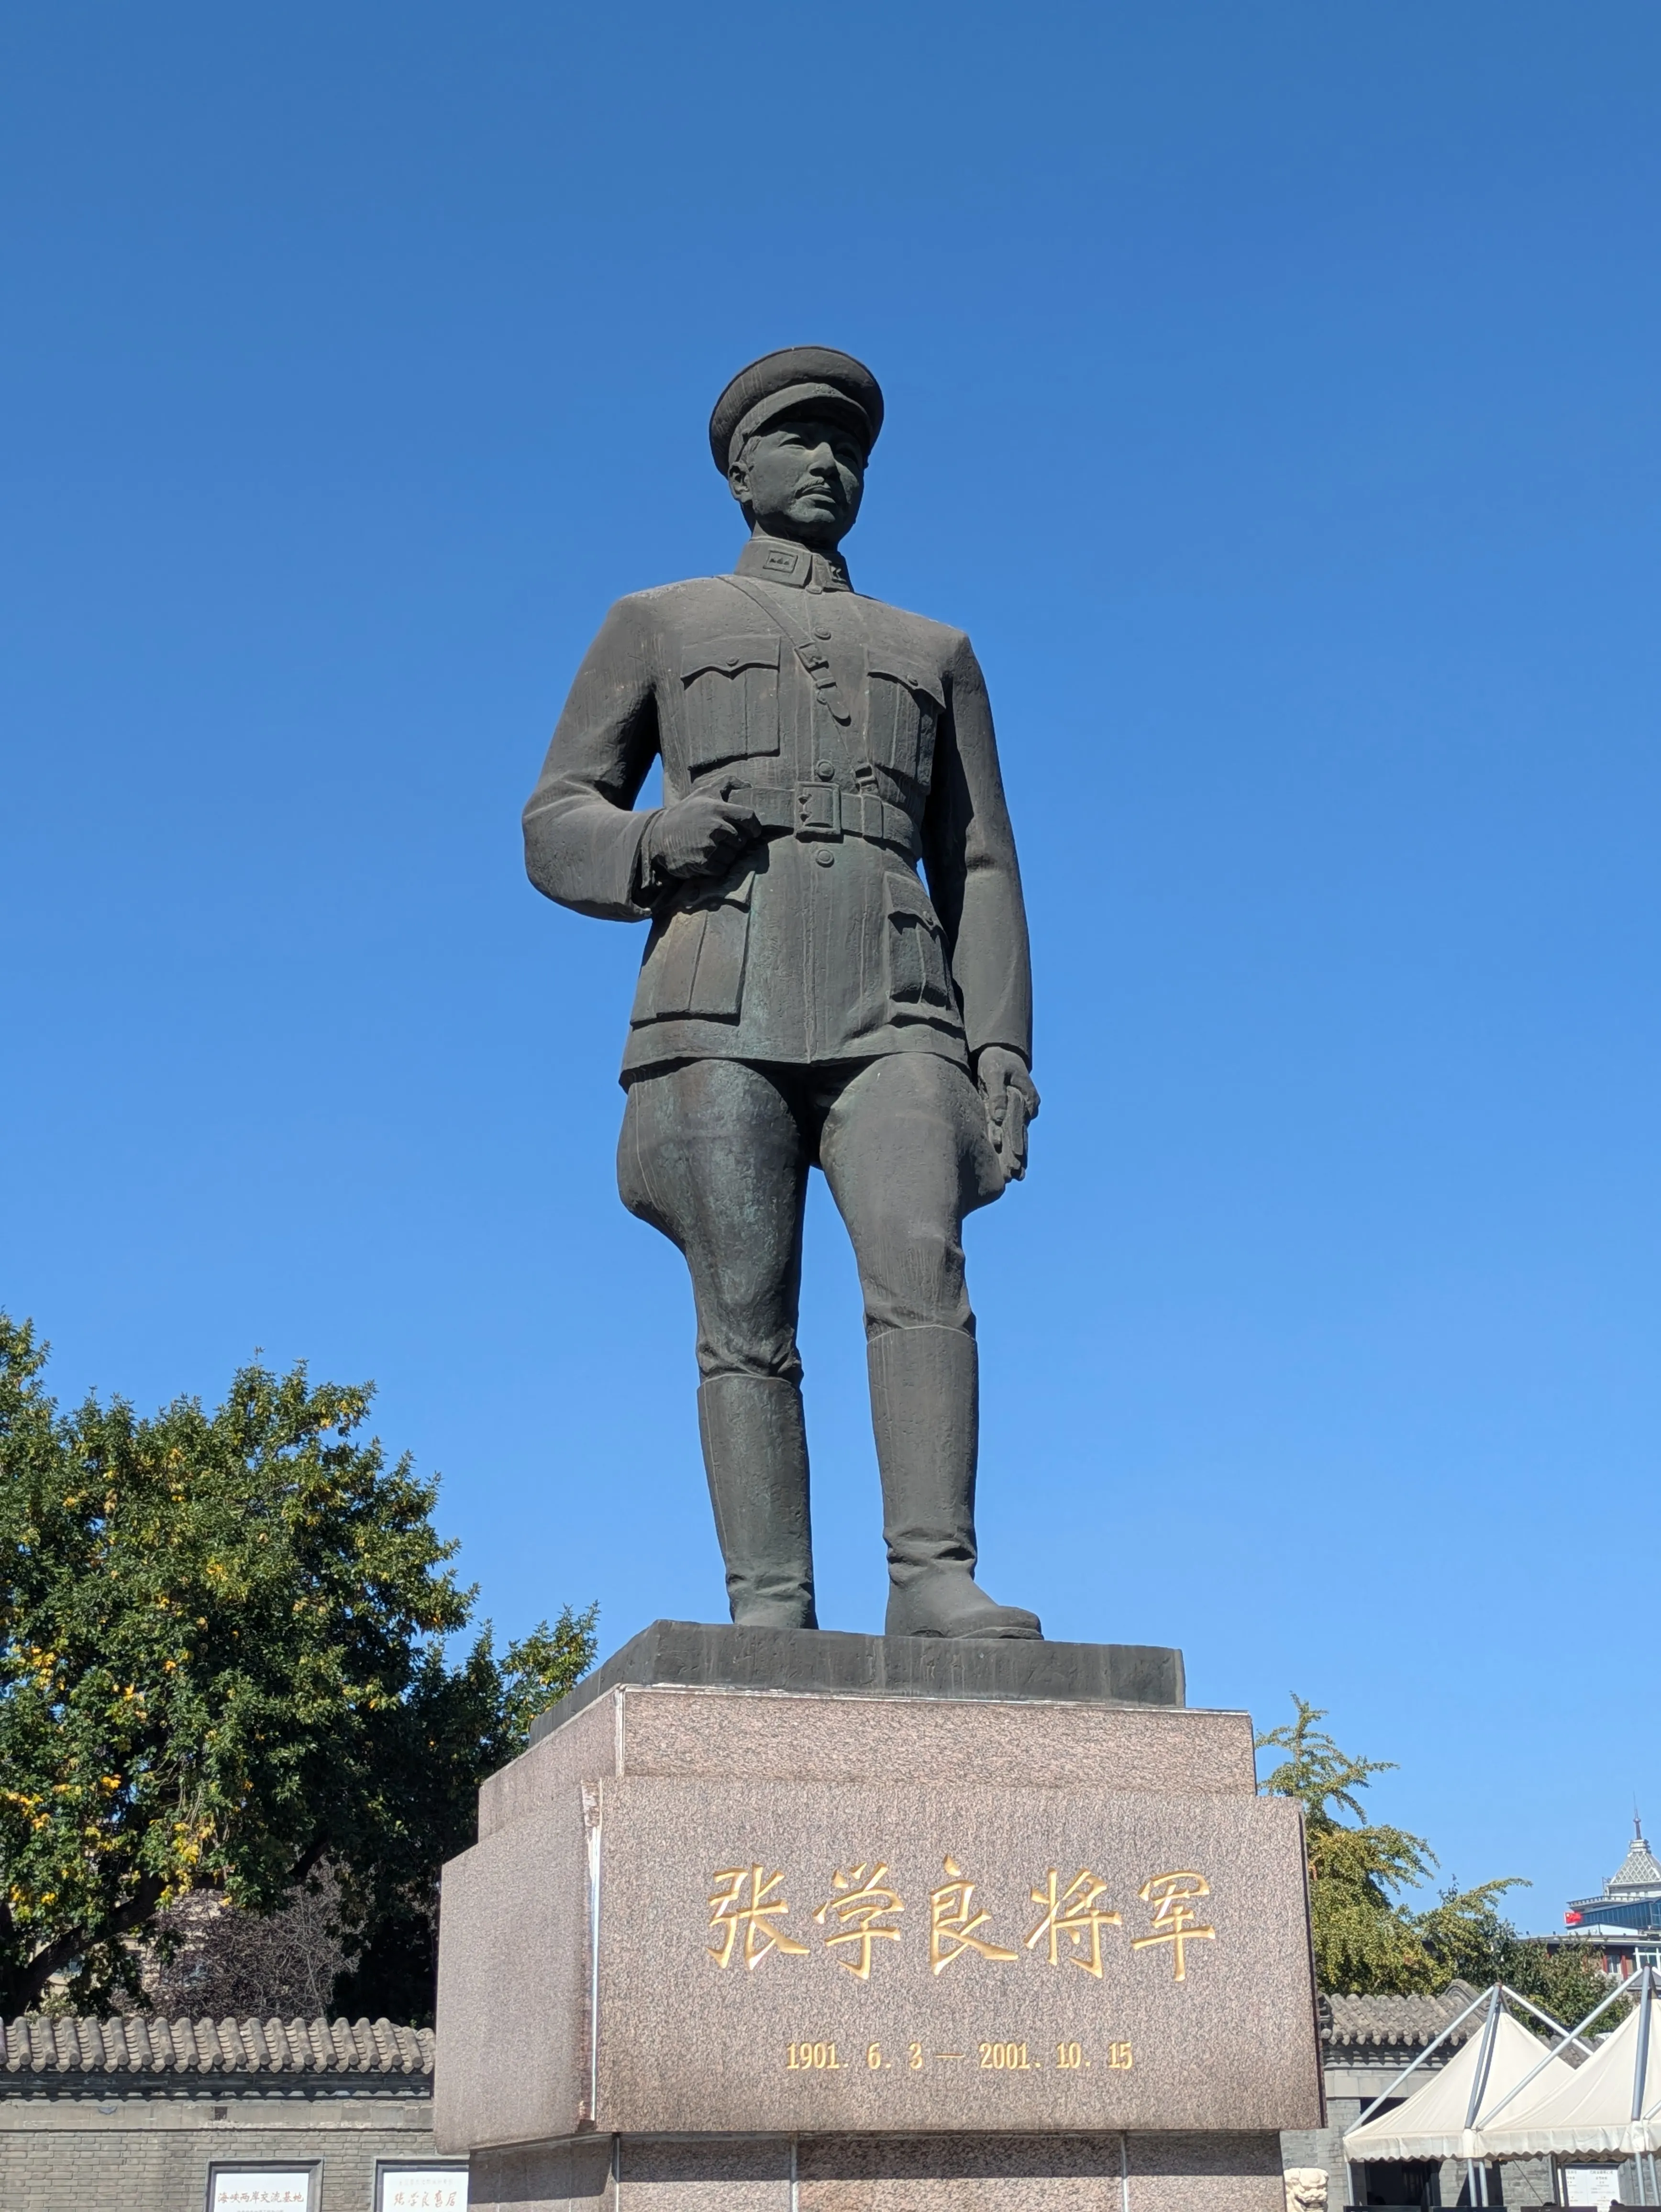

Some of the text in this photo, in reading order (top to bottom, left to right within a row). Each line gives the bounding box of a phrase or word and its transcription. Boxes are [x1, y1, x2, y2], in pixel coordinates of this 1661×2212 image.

[707, 1855, 1216, 1981] 张学良将军
[218, 2190, 304, 2203] 海峡两岸交流基地
